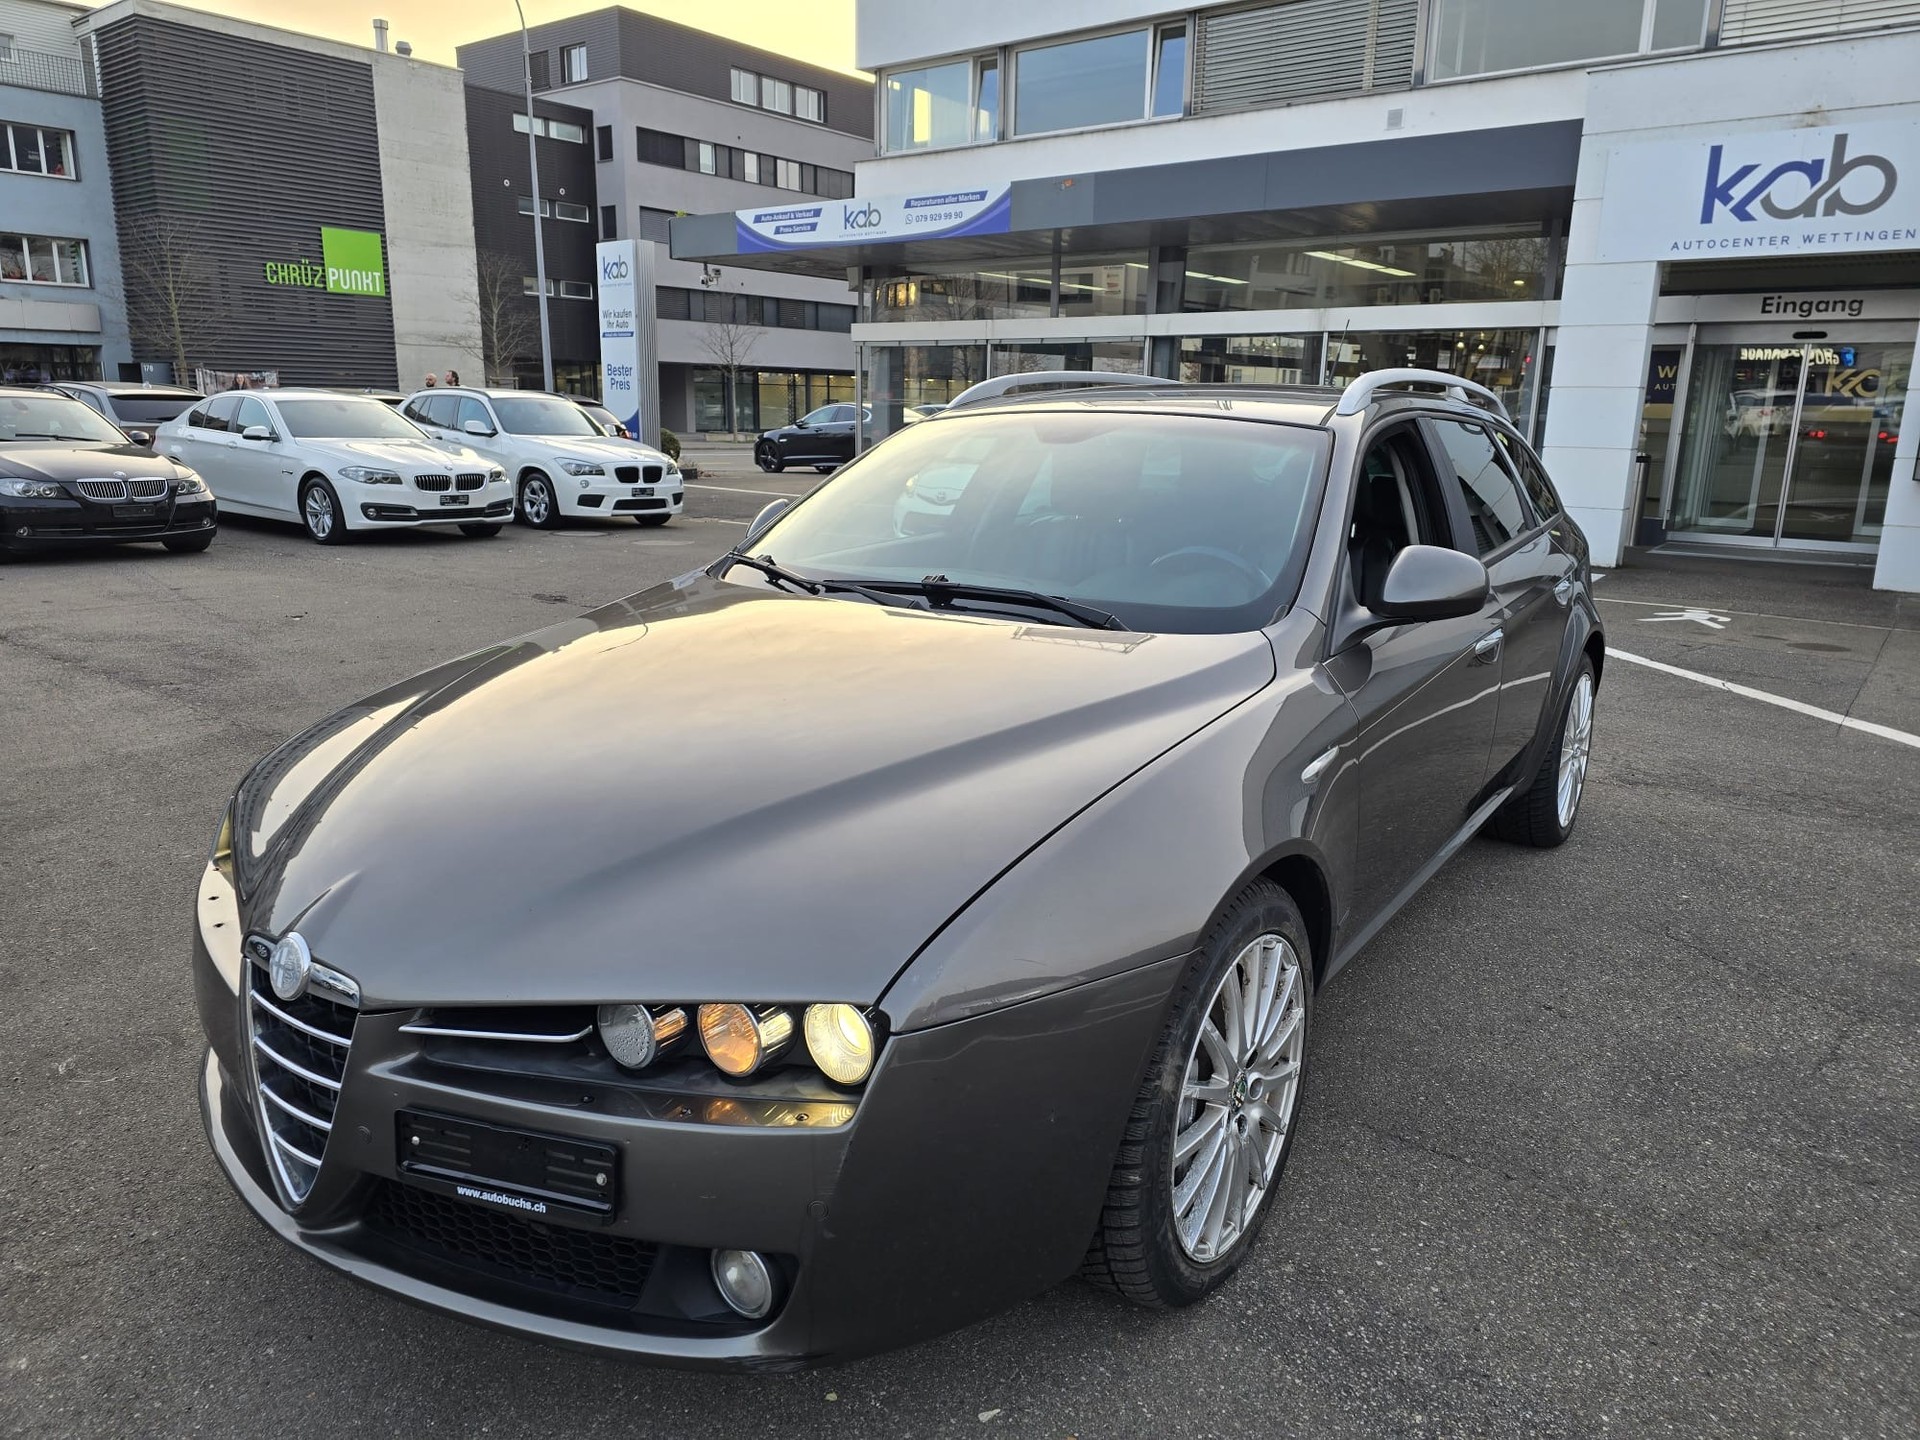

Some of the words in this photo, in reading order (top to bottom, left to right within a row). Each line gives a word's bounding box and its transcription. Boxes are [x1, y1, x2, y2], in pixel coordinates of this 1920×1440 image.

[1700, 133, 1897, 225] kab
[843, 202, 881, 230] kab
[915, 214, 928, 223] 079
[929, 213, 942, 222] 929
[943, 212, 952, 221] 99
[953, 210, 963, 219] 90
[1670, 235, 1790, 251] AUTOCENTER
[1802, 228, 1917, 244] WETTINGEN
[266, 258, 324, 288] CHRÜZ
[328, 267, 381, 293] PUNKT
[602, 254, 628, 280] kab
[602, 309, 612, 319] Wir
[613, 308, 632, 319] kaufen
[1760, 295, 1864, 318] Eingang
[607, 319, 615, 329] Ihr
[616, 318, 629, 329] Auto
[607, 363, 632, 377] Bester
[1657, 365, 1677, 378] W
[610, 377, 631, 391] Preis
[1654, 383, 1677, 391] AUT
[457, 1185, 547, 1214] www.autobuchs.ch
